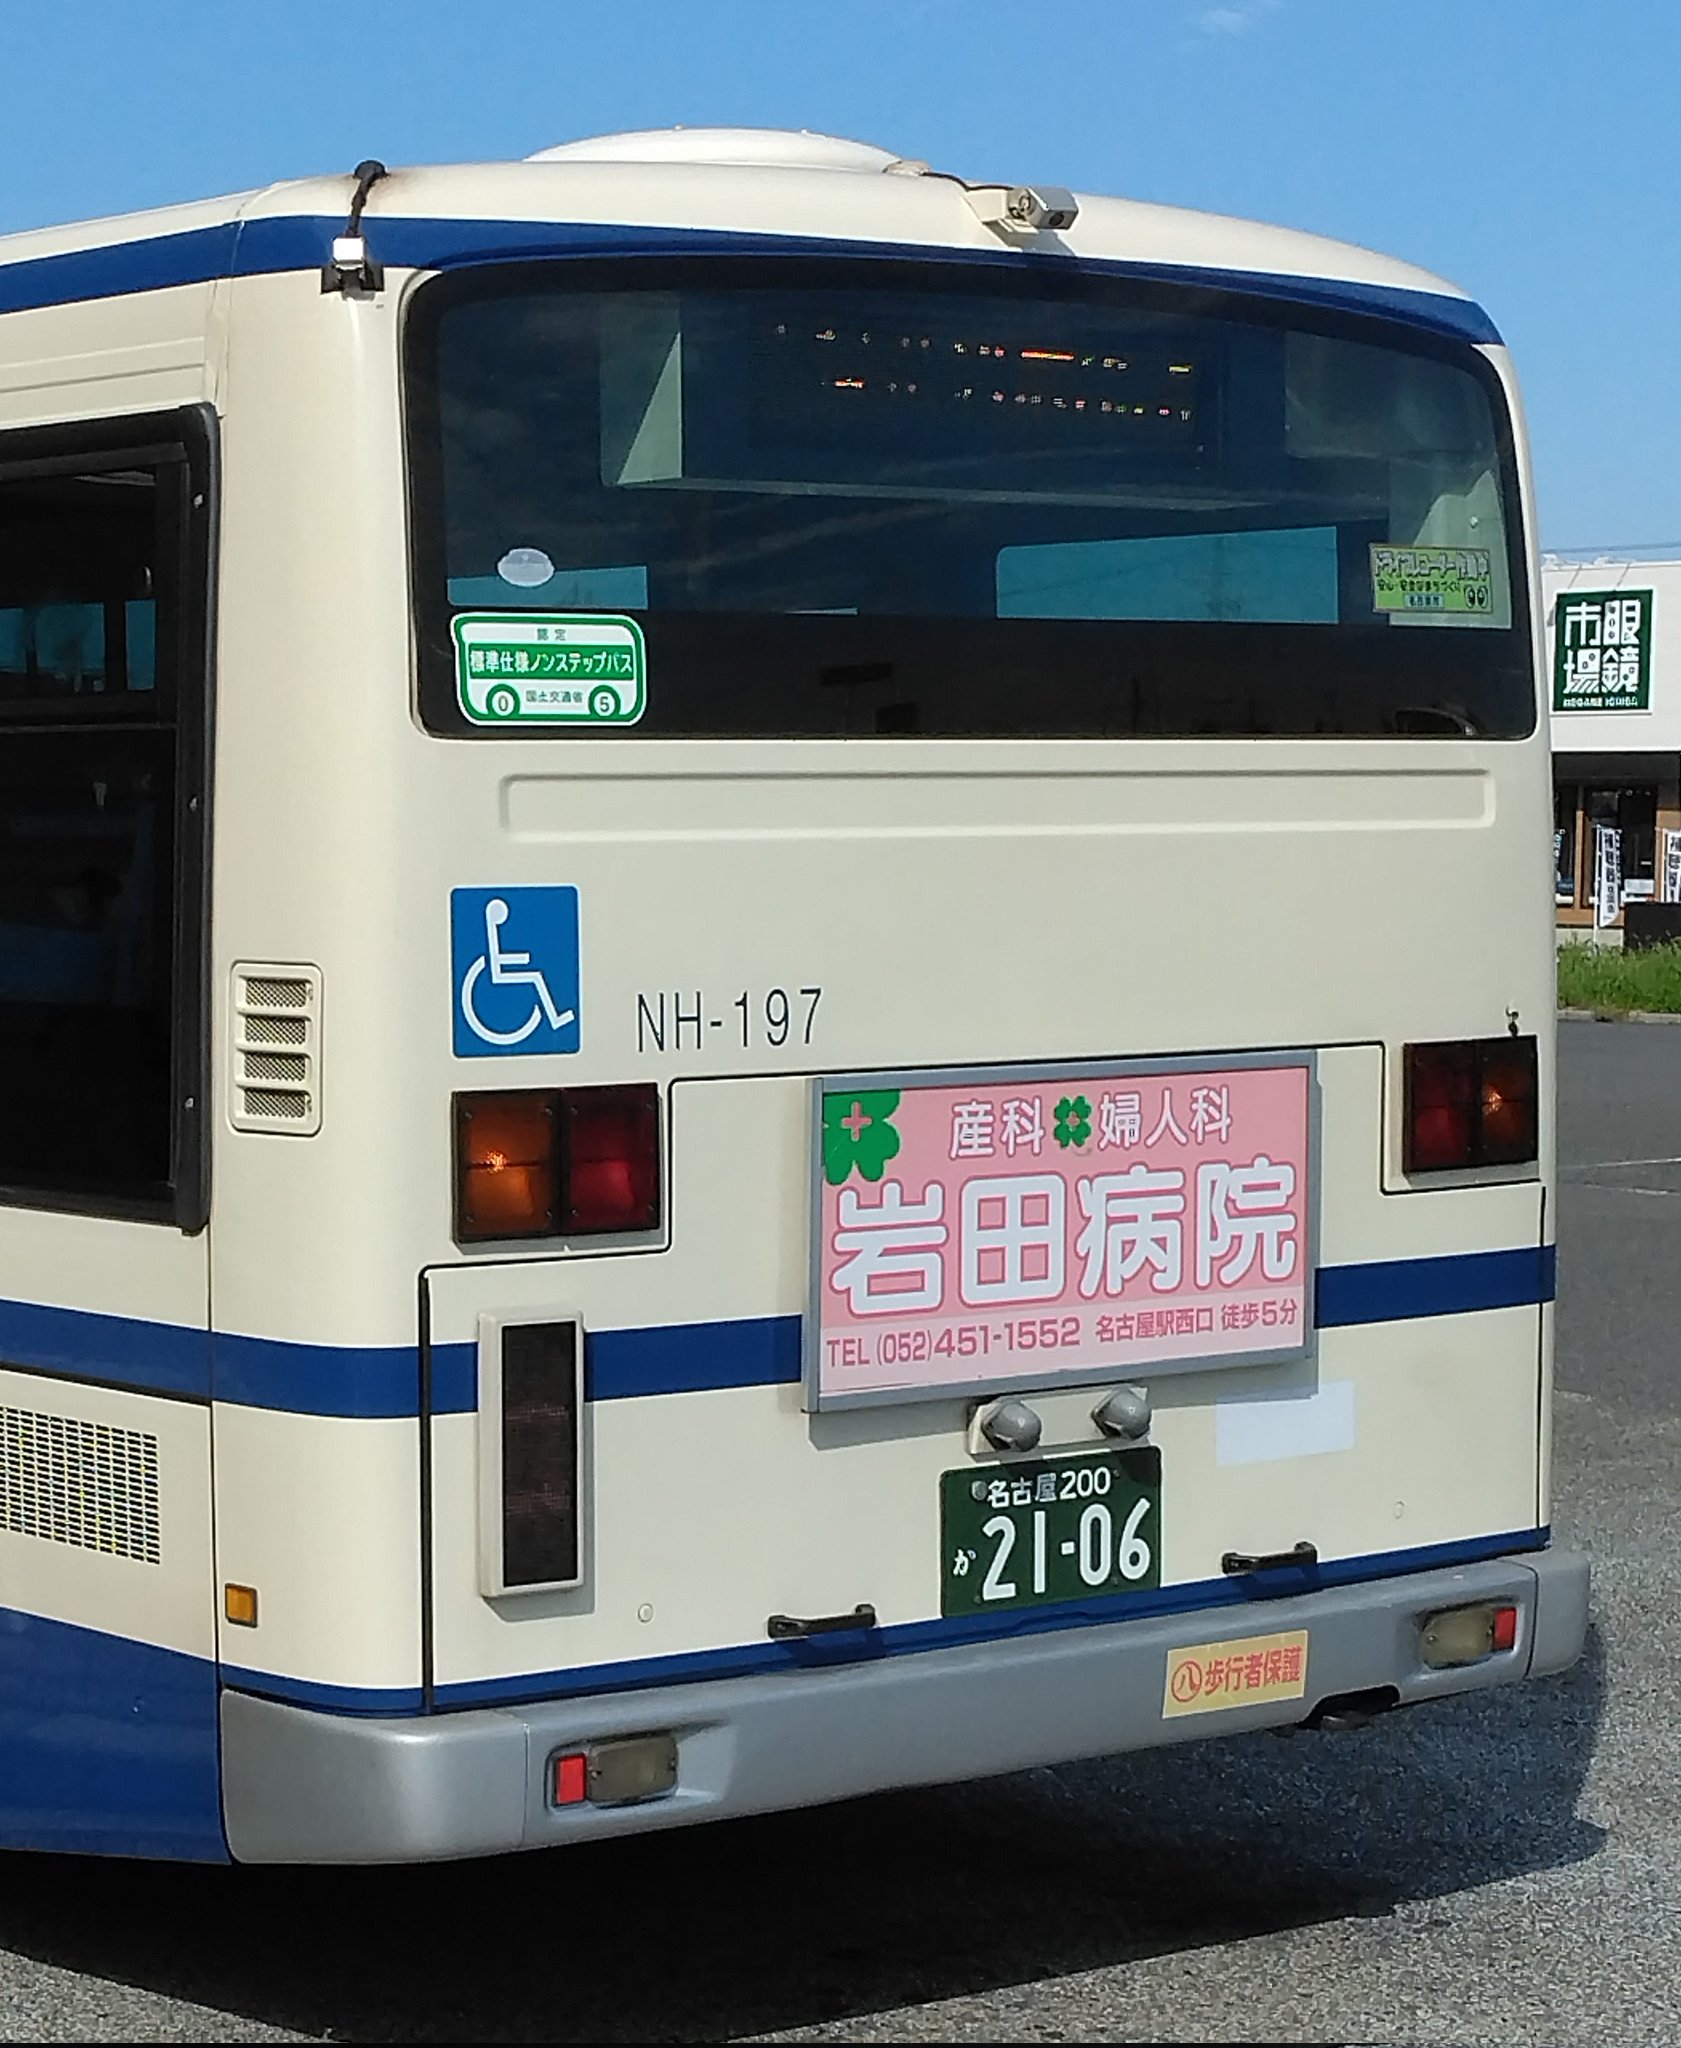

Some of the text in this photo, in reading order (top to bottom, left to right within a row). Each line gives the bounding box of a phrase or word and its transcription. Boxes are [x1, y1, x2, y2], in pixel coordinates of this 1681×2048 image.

[637, 987, 822, 1053] NH-197
[950, 1085, 1232, 1159] 産科 婦人科
[829, 1155, 1296, 1319] 岩田病院
[827, 1298, 1298, 1367] TEL (052)451-1552 名古屋駅西口 徒歩5分
[987, 1467, 1111, 1508] 名古屋 200
[953, 1497, 1151, 1600] か 21-06
